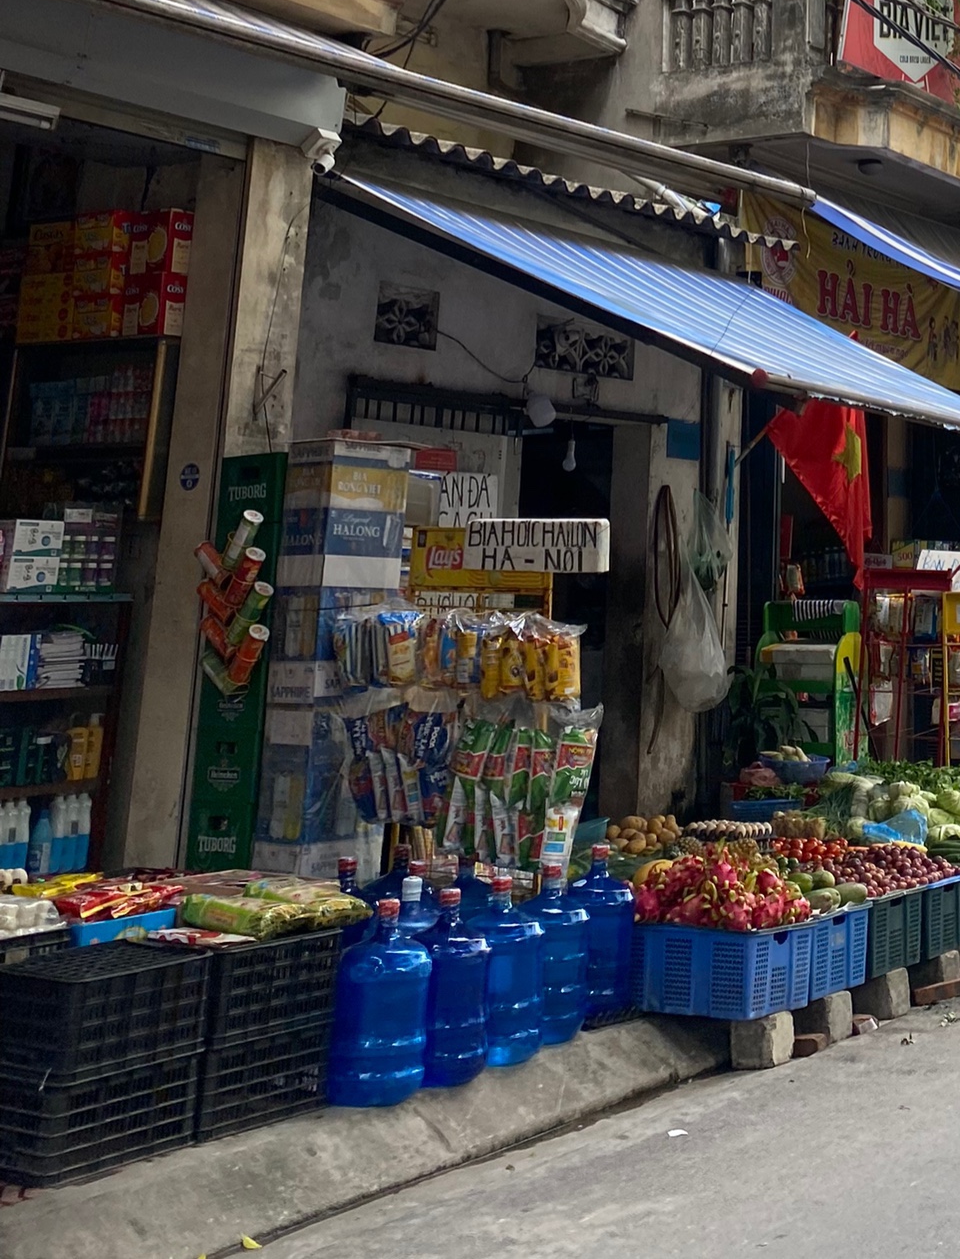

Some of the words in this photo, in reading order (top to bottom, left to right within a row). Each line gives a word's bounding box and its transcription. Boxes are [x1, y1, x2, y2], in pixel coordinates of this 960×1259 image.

[816, 259, 873, 328] HẢI
[879, 283, 922, 341] HÀ
[228, 482, 267, 502] TUBORG
[440, 470, 464, 508] ÁN
[333, 523, 380, 538] HALONG
[468, 520, 499, 548] BIA
[209, 768, 239, 781] Heineken
[198, 835, 237, 854] TUBORG
